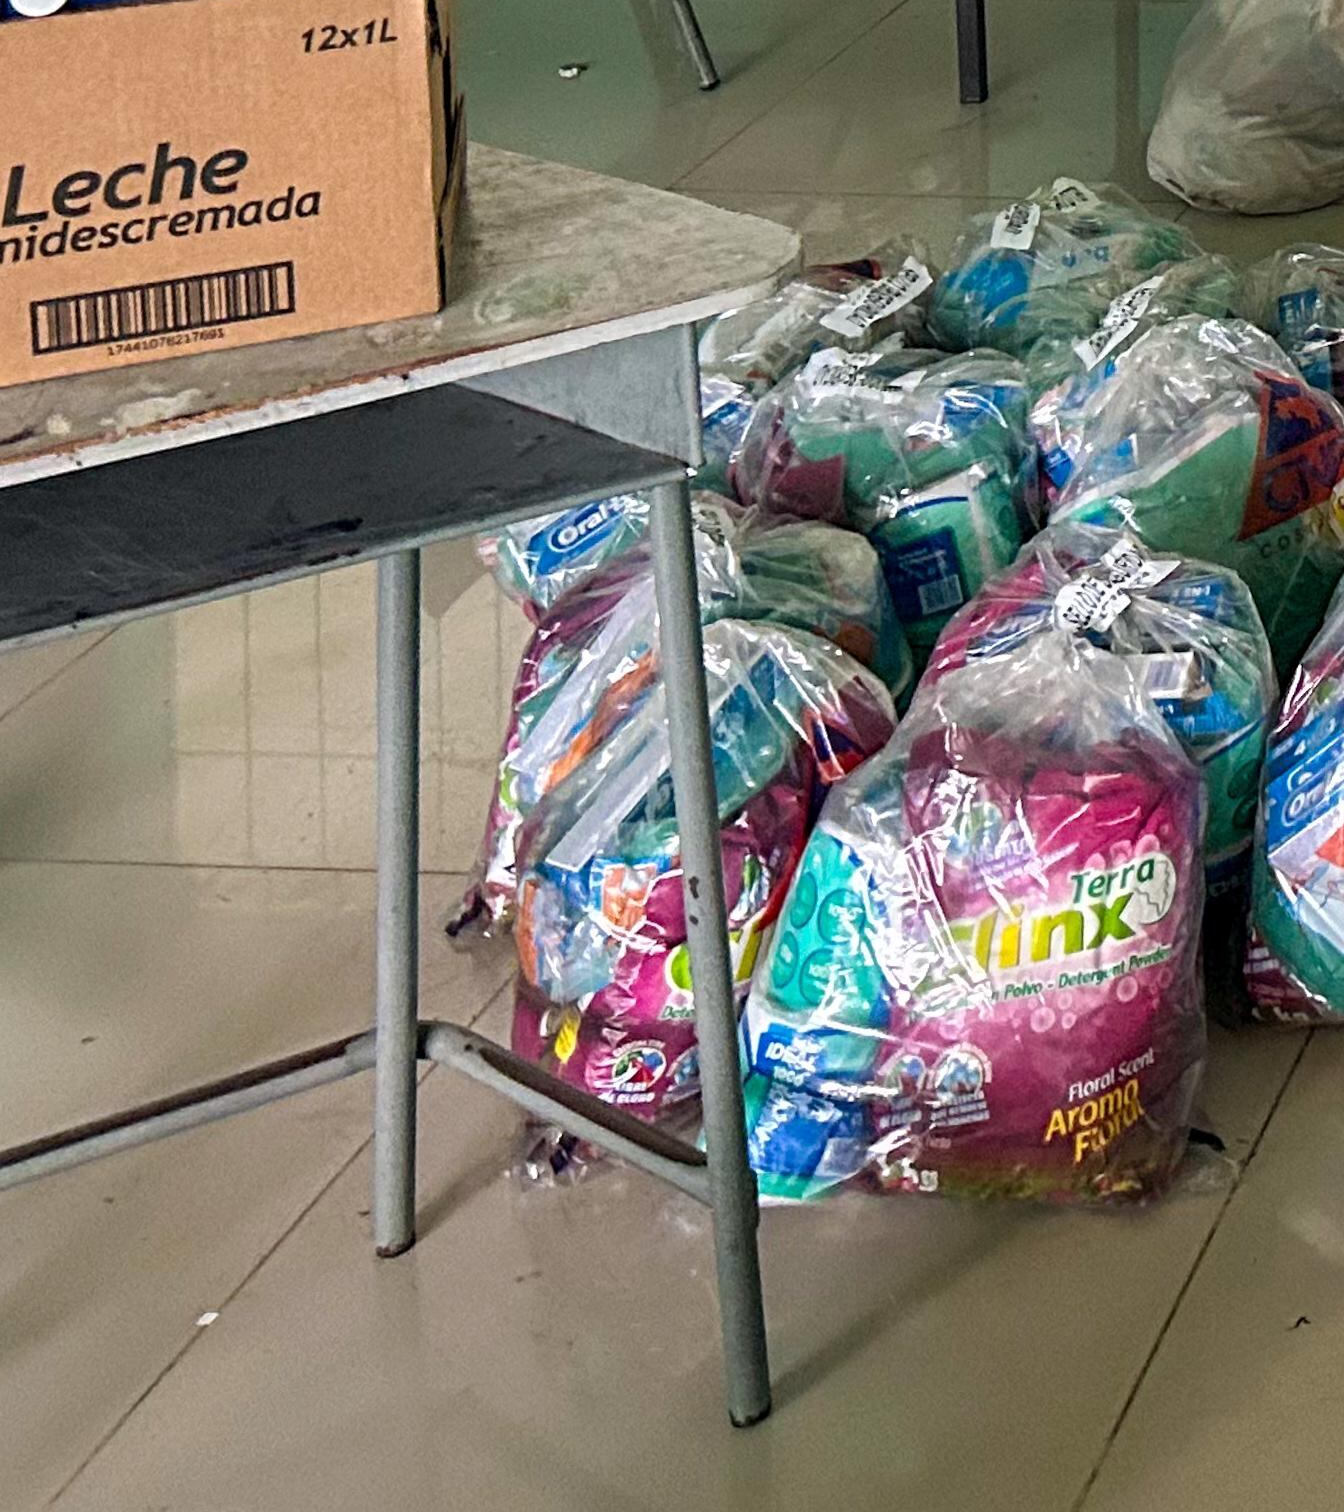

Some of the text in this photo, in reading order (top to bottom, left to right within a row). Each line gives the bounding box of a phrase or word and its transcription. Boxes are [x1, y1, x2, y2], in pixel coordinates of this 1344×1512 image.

[301, 18, 398, 54] 12x1L
[2, 140, 250, 228] Leche
[1070, 857, 1156, 906] Terra
[950, 890, 1138, 970] linx
[1067, 1047, 1156, 1103] Floral Scent
[1044, 1078, 1140, 1144] Aroma
